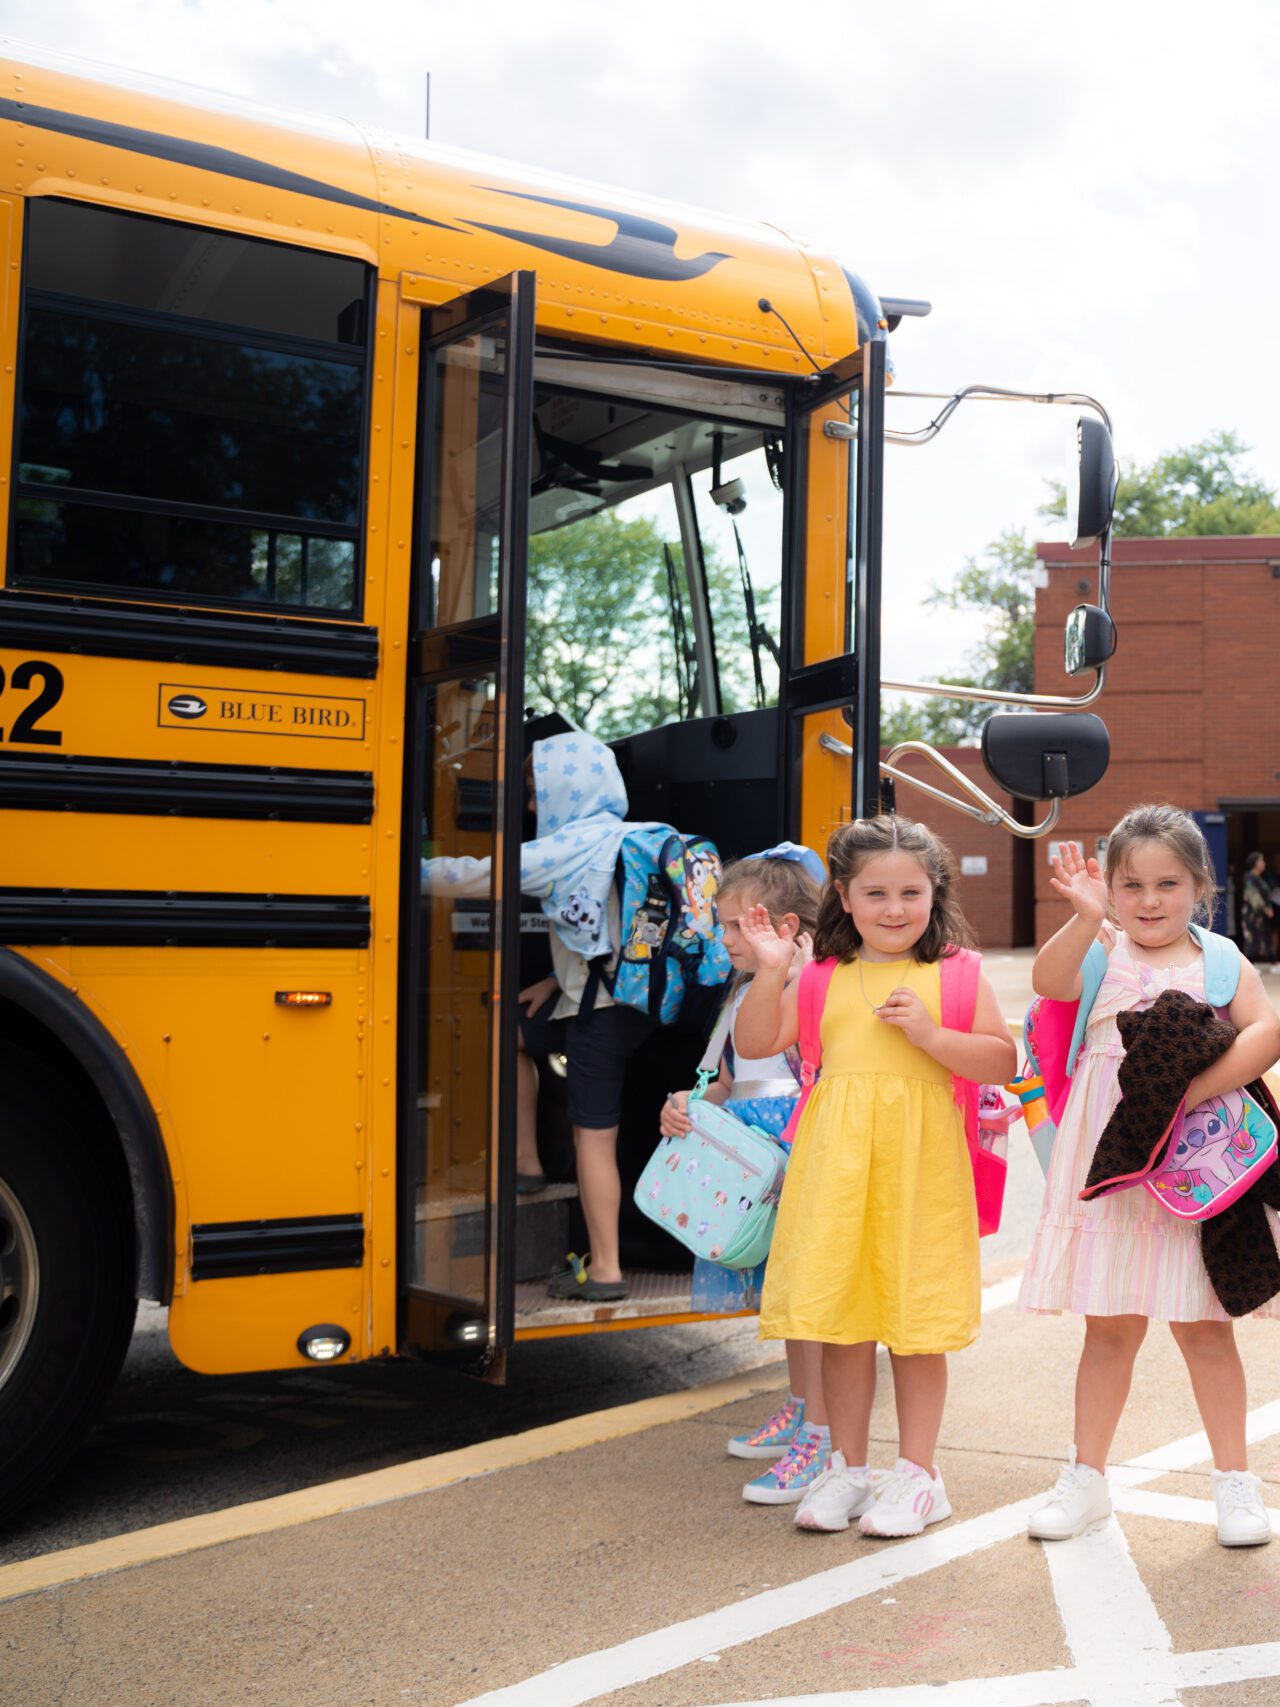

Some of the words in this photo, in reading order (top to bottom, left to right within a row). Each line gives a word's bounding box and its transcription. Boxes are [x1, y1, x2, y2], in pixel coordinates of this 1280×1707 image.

[0, 660, 64, 746] 2
[220, 701, 283, 723] BLUE
[292, 706, 350, 728] BIRD
